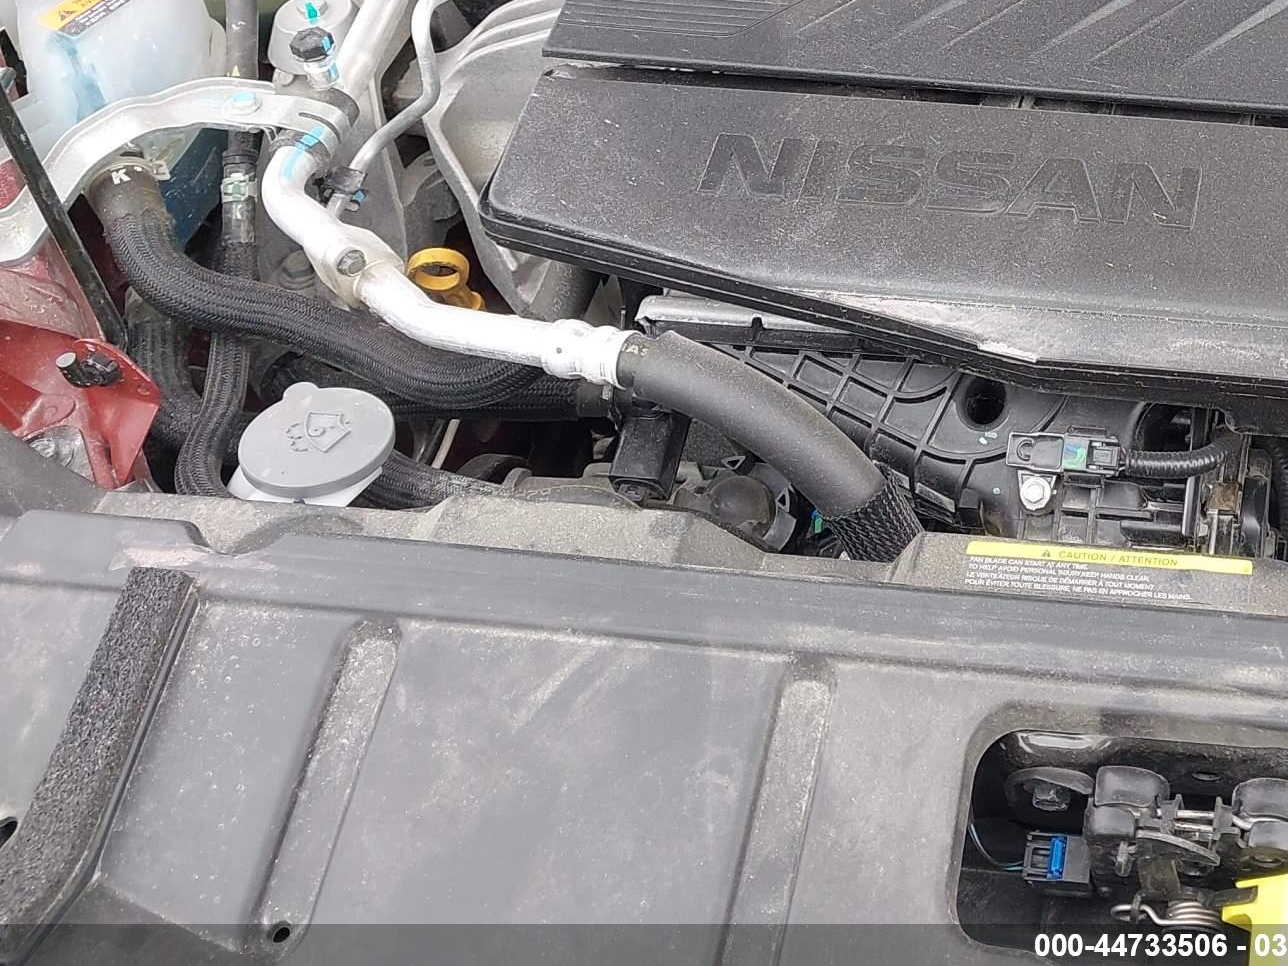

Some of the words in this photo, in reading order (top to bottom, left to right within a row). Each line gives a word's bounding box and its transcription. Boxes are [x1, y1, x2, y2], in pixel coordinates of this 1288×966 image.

[697, 133, 1202, 230] NISSAN
[1058, 551, 1107, 561] CAUTION
[1118, 555, 1178, 566] ATTENTION
[976, 572, 1020, 581] VENTILATEUR
[1105, 580, 1123, 588] TOUT
[979, 564, 997, 572] HELP
[998, 565, 1019, 573] AVOID
[1020, 566, 1056, 575] PERSONAL
[1101, 572, 1126, 581] HANDS
[965, 578, 985, 586] POUR
[1010, 581, 1033, 589] TOUTE
[1109, 589, 1152, 599] APPROCHER
[1154, 591, 1167, 599] LES
